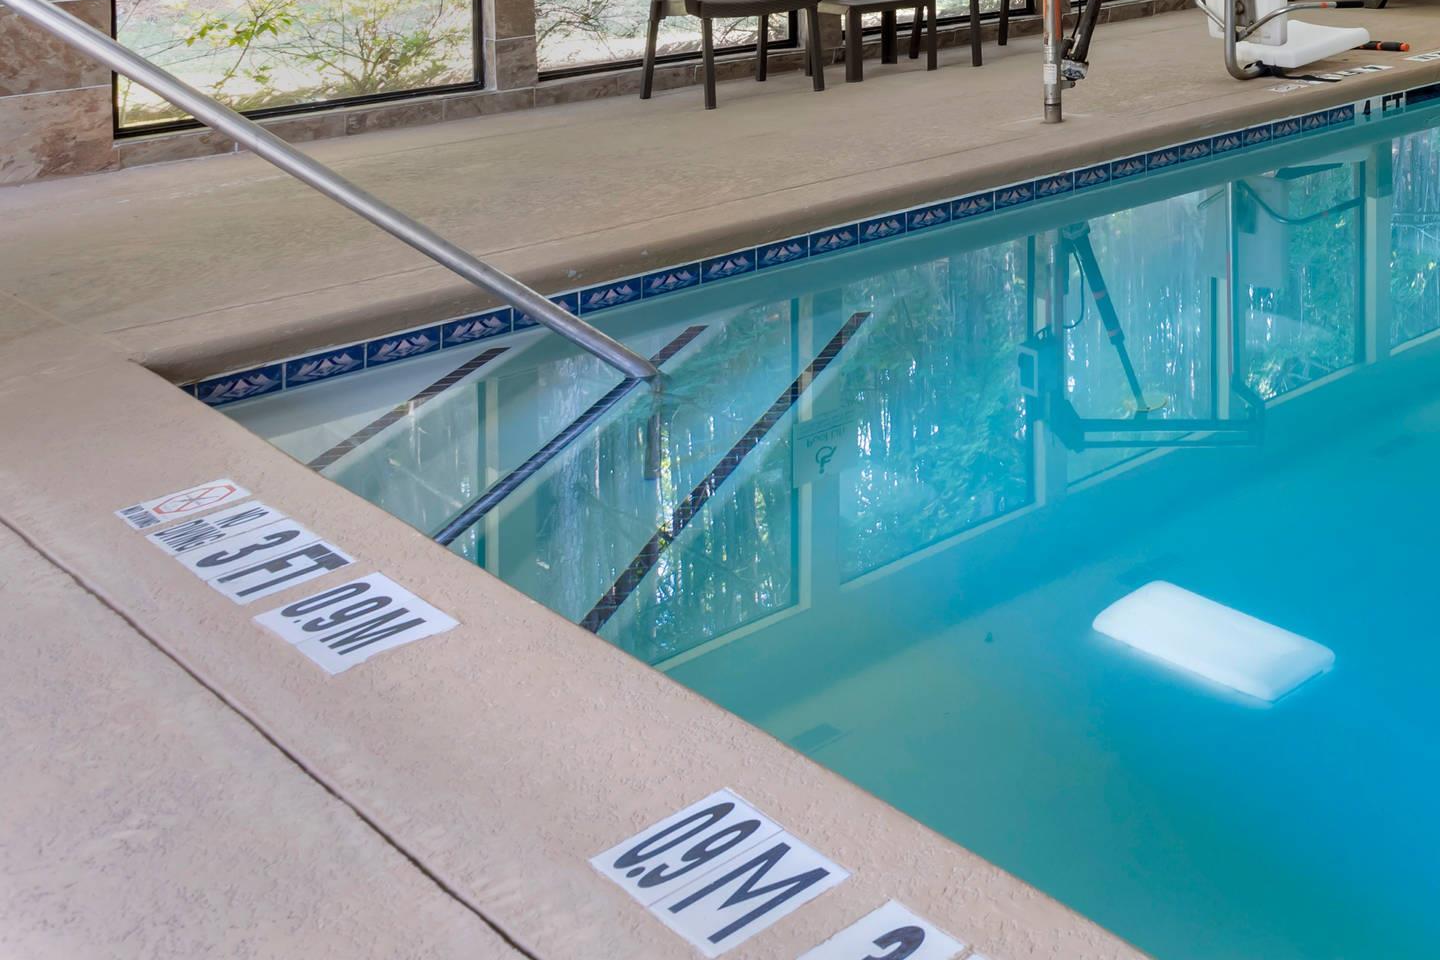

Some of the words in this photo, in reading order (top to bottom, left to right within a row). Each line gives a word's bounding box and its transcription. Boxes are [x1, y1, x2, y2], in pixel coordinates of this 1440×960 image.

[154, 518, 227, 553] DIVING
[216, 506, 270, 529] NO
[196, 530, 300, 568] 3
[217, 543, 350, 597] FT
[281, 582, 427, 656] 0.9M
[613, 802, 831, 944] 0.9M
